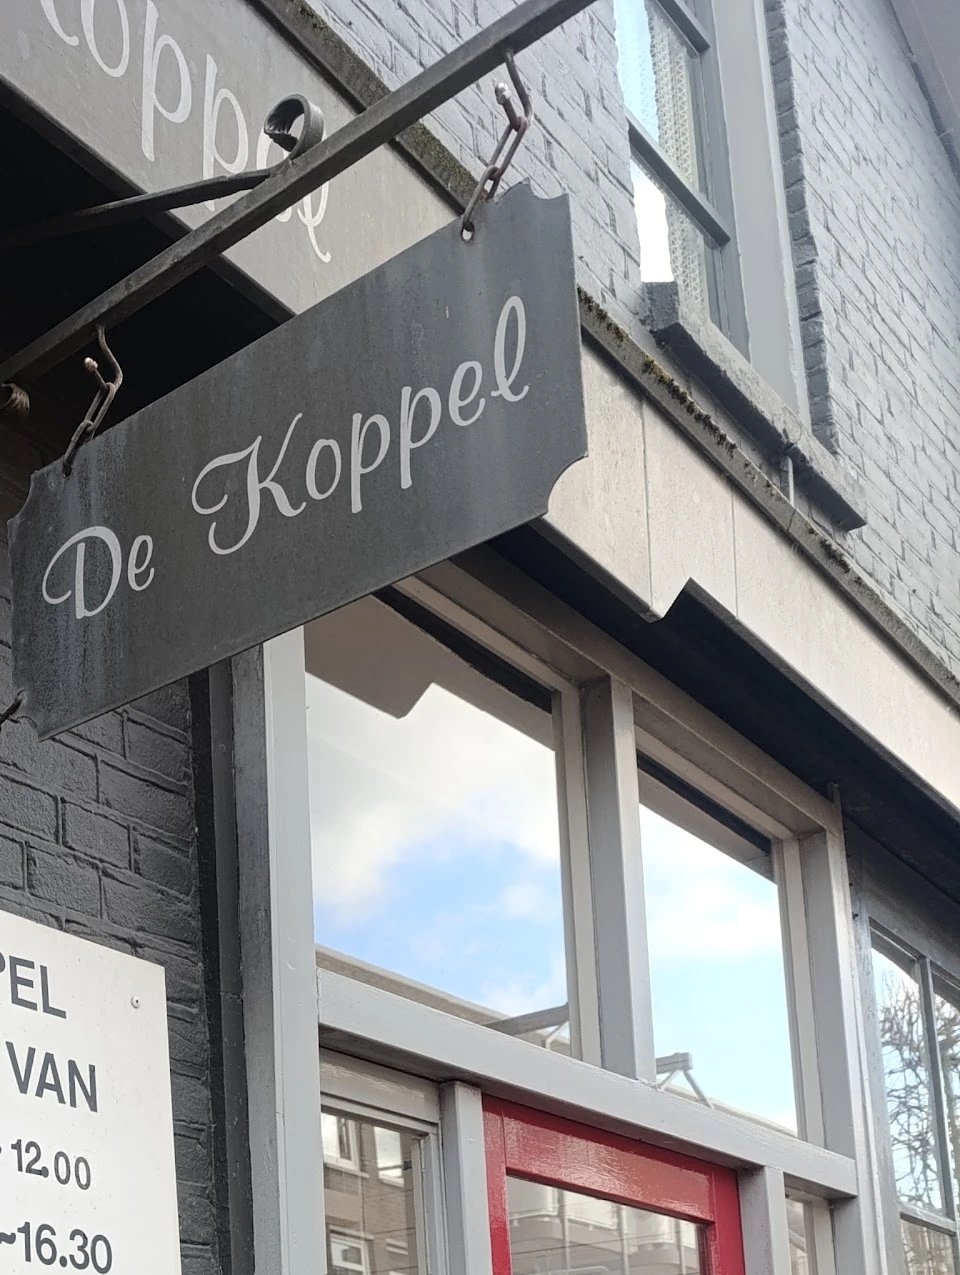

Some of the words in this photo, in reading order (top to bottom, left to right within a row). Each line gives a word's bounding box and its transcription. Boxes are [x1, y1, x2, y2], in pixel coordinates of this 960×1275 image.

[41, 525, 155, 620] De
[191, 295, 530, 555] Koppel
[5, 1041, 99, 1113] VAN
